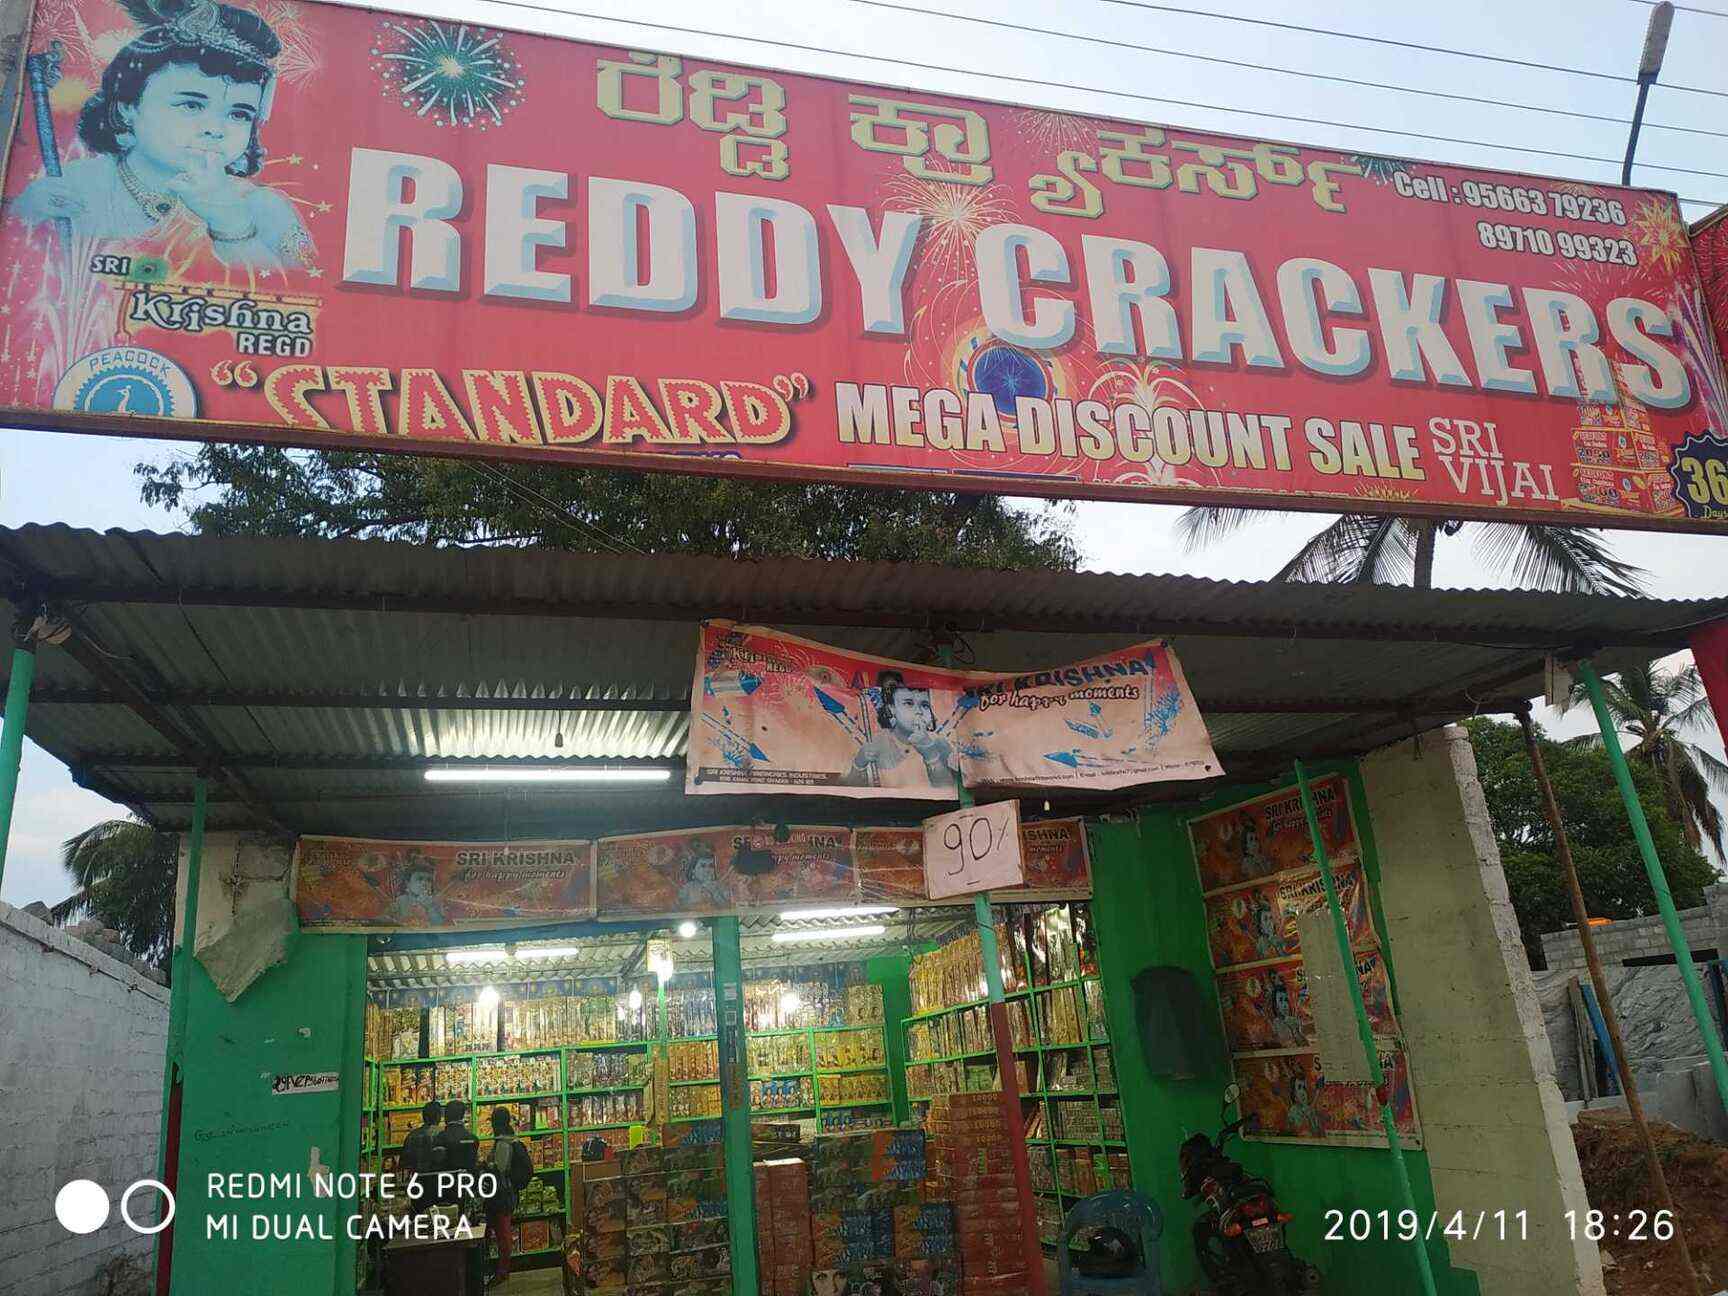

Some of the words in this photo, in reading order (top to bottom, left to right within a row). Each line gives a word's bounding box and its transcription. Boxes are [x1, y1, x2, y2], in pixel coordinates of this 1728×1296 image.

[1393, 171, 1449, 202] Cell
[1461, 180, 1548, 216] 95663
[1547, 191, 1627, 227] 79236
[1476, 221, 1555, 255] 89710
[1555, 230, 1640, 267] 99323
[91, 255, 130, 276] SRI
[342, 147, 924, 335] REDDY
[976, 222, 1694, 409] CRACKERS
[130, 291, 313, 333] Krishna
[89, 349, 174, 378] PEACOCK
[236, 332, 314, 358] REGD
[834, 382, 1006, 452] MEGA
[1017, 396, 1292, 473] DISCOUNT
[1304, 416, 1427, 481] SALE
[1428, 416, 1504, 458] SRI
[1438, 455, 1560, 506] VIJAI
[1068, 683, 1140, 700] moments
[493, 850, 576, 866] KRISHNA
